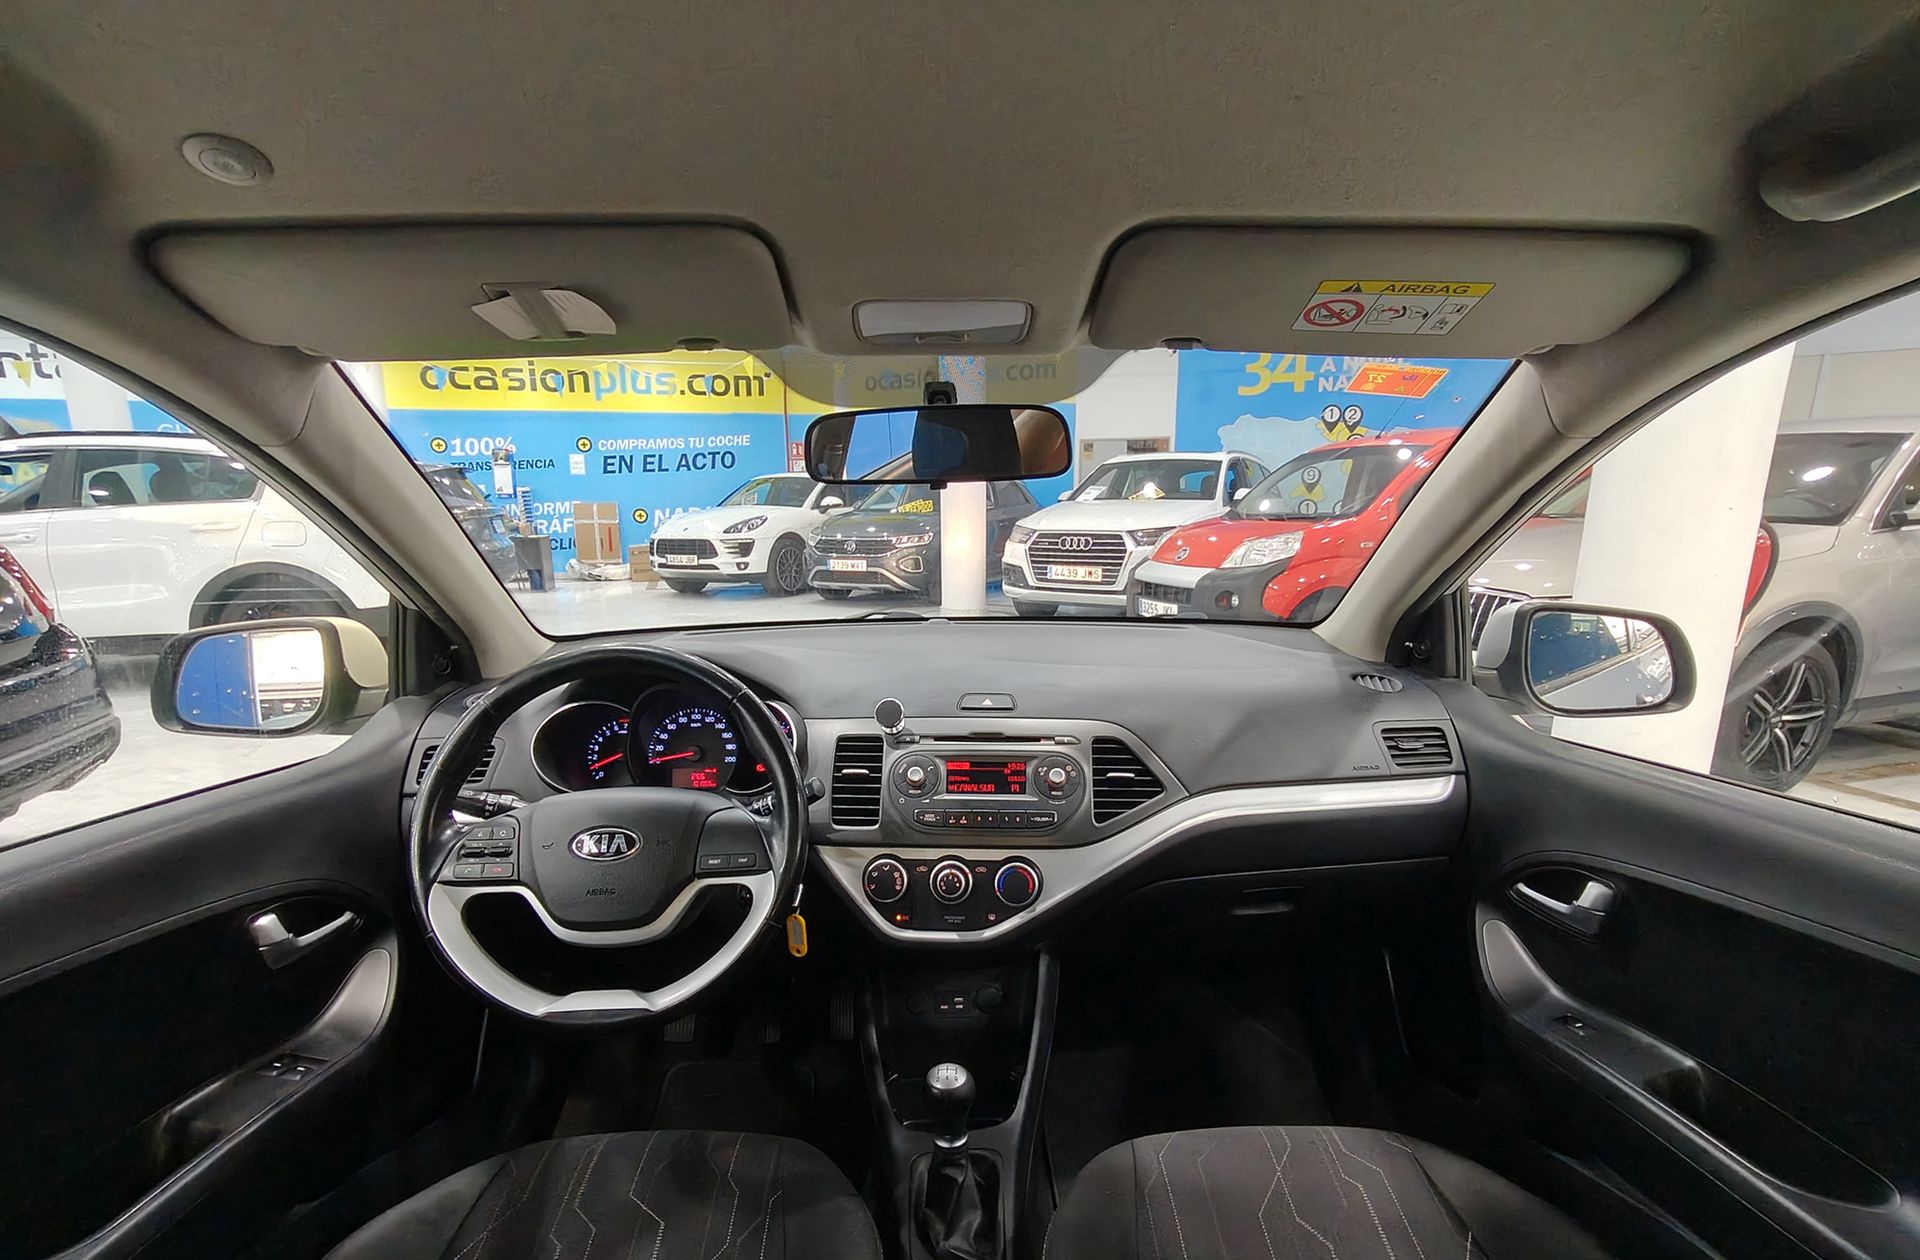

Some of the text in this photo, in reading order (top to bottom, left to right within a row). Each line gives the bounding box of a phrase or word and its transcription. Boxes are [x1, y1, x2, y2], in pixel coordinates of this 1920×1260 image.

[1381, 283, 1471, 294] AIRBAG
[419, 360, 765, 402] ocasionplus.com
[1238, 353, 1315, 396] 34
[1348, 408, 1358, 420] 2
[450, 436, 517, 457] 100%
[598, 435, 751, 451] COMPRAMOS TU COCHE
[450, 459, 555, 473] TRANSRENCIA
[602, 451, 736, 474] EN EL ACTO
[1054, 568, 1078, 578] 4439
[582, 833, 628, 854] KIA
[585, 887, 617, 897] AIRBAG
